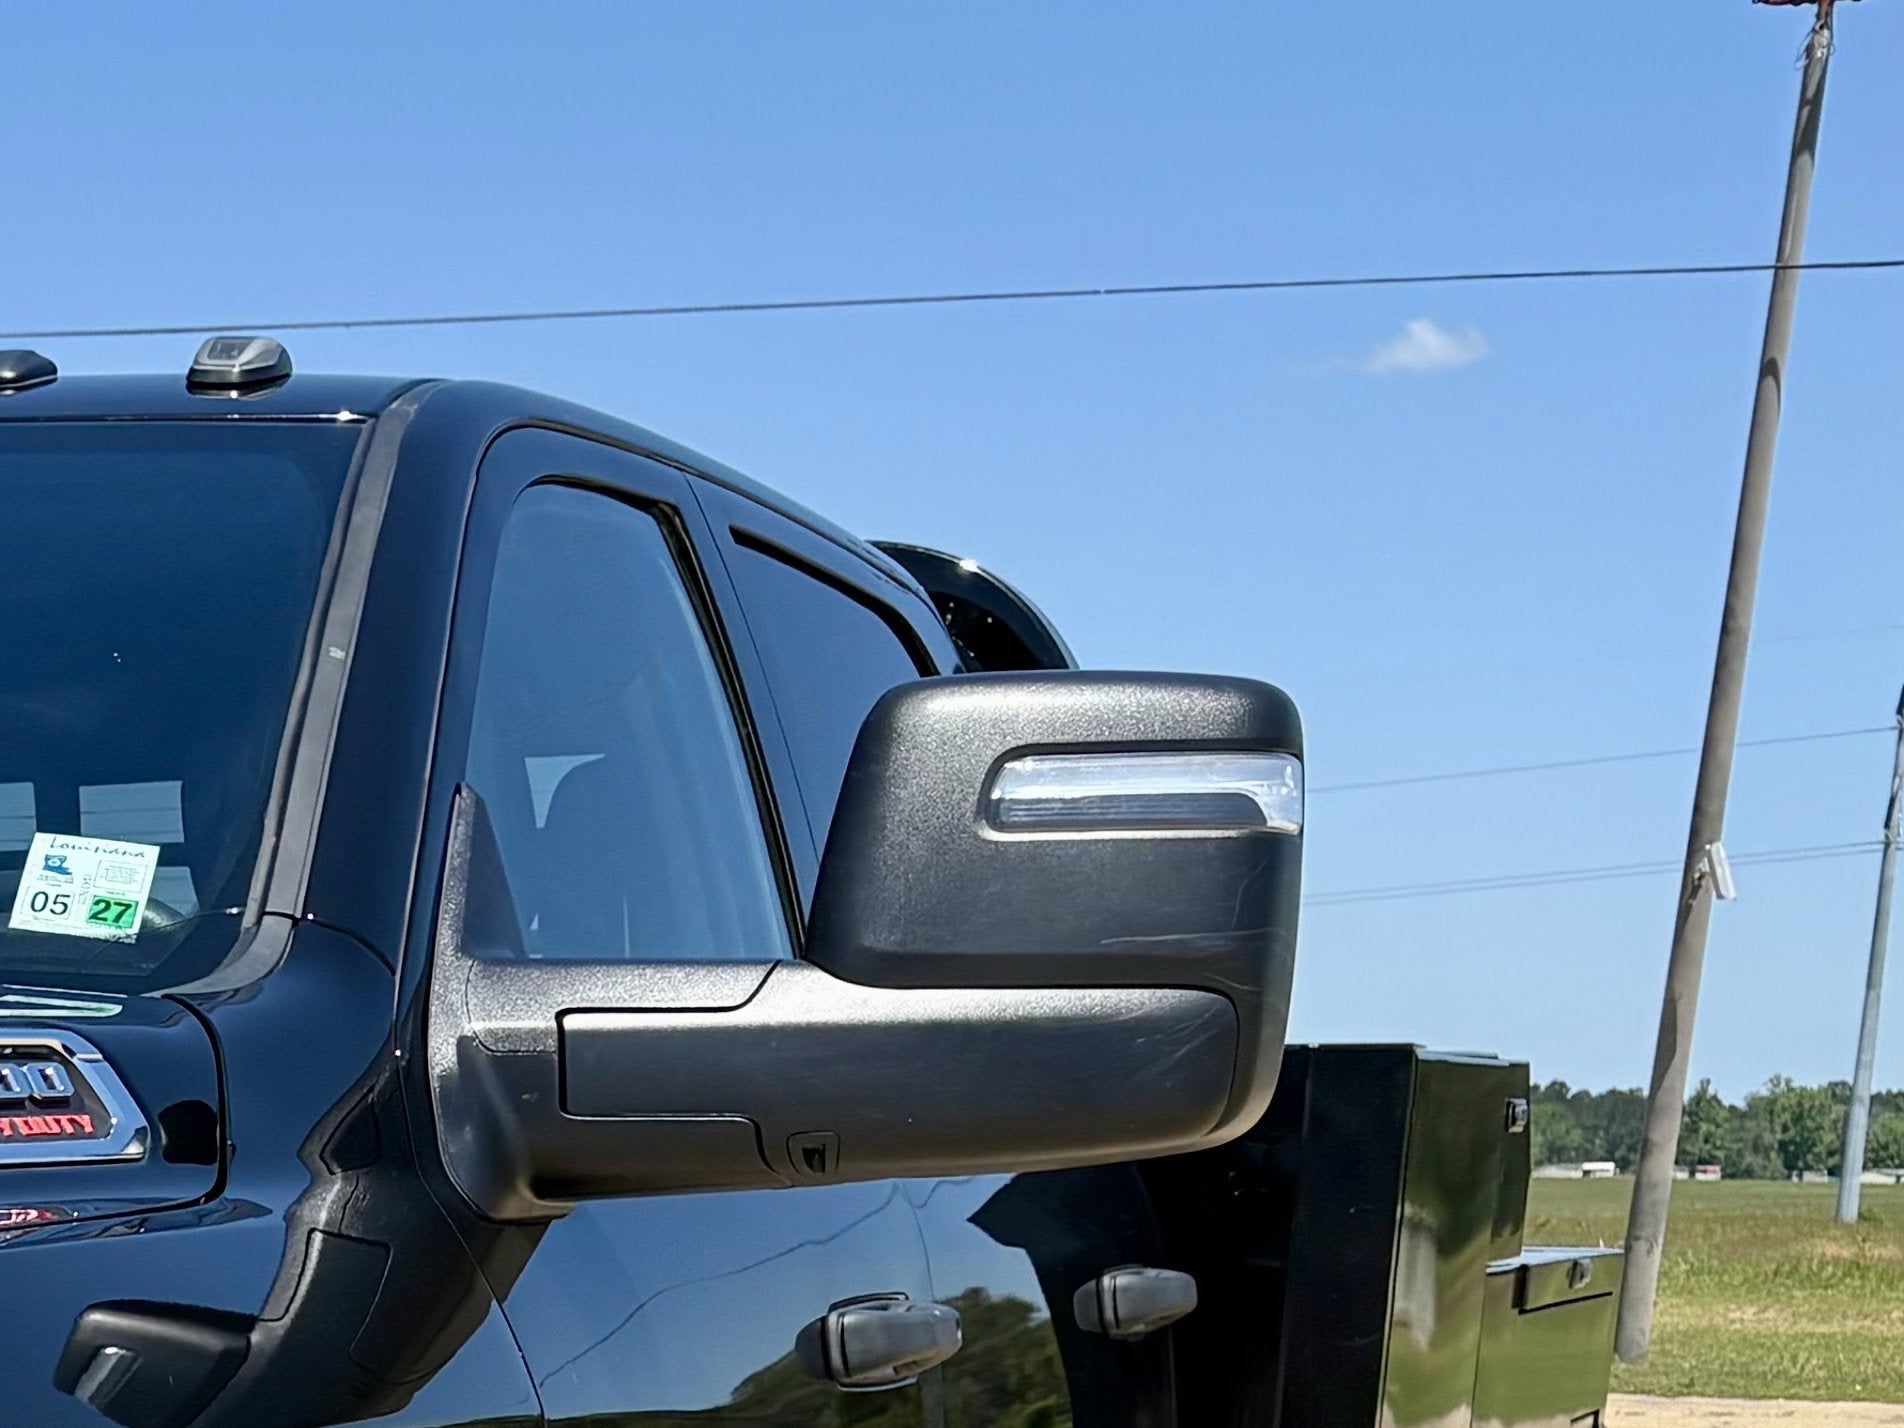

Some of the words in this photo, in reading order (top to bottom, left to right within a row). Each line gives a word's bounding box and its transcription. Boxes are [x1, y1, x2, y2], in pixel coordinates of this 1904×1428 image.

[29, 890, 72, 916] 05
[88, 898, 134, 924] 27
[14, 1113, 94, 1137] DUTY
